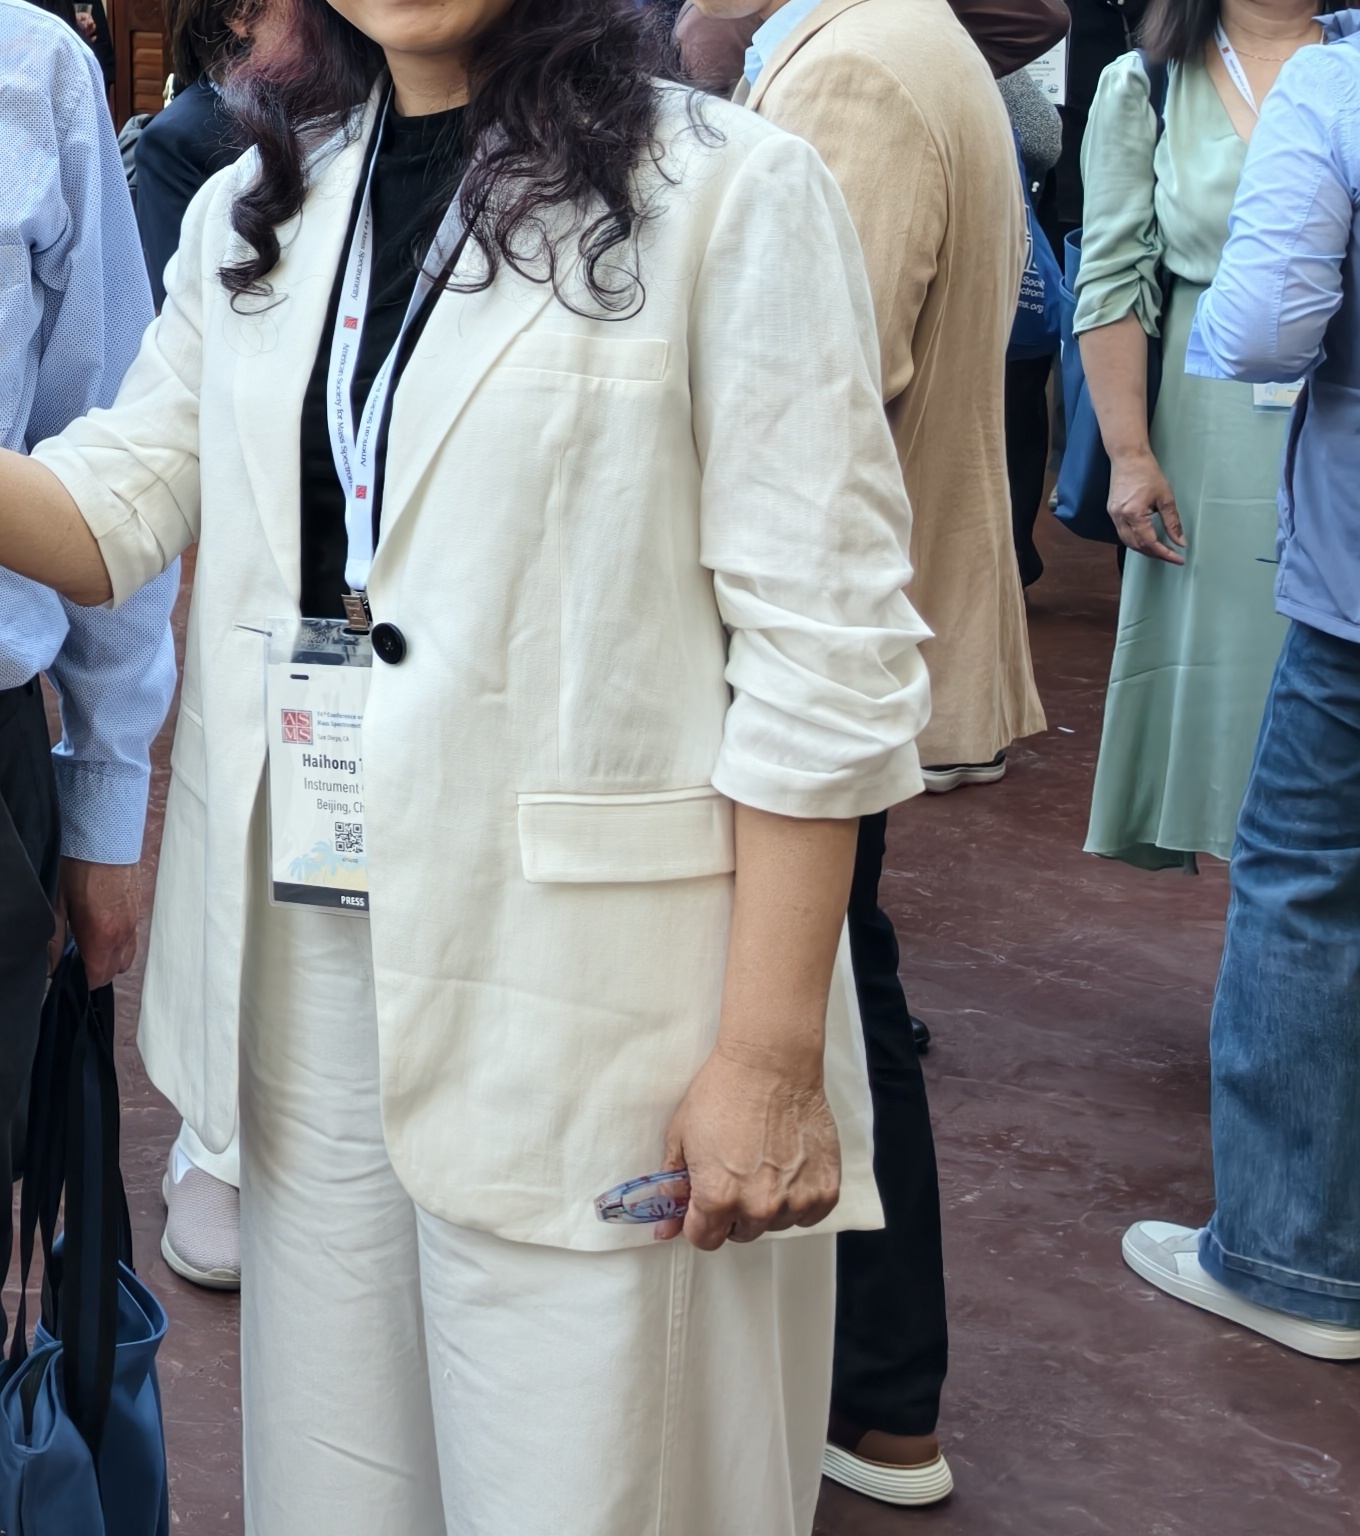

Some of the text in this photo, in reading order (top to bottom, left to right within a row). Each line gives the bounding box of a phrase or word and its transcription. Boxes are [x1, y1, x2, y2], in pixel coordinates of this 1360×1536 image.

[351, 250, 366, 301] Spectrometry
[338, 343, 350, 377] American
[334, 377, 344, 408] Society
[337, 421, 345, 444] Mass
[360, 426, 371, 467] American
[367, 394, 379, 424] Society
[302, 753, 356, 775] Haihong
[304, 777, 359, 794] Instrument
[317, 798, 351, 815] Beijing,
[340, 895, 365, 907] PRESS
